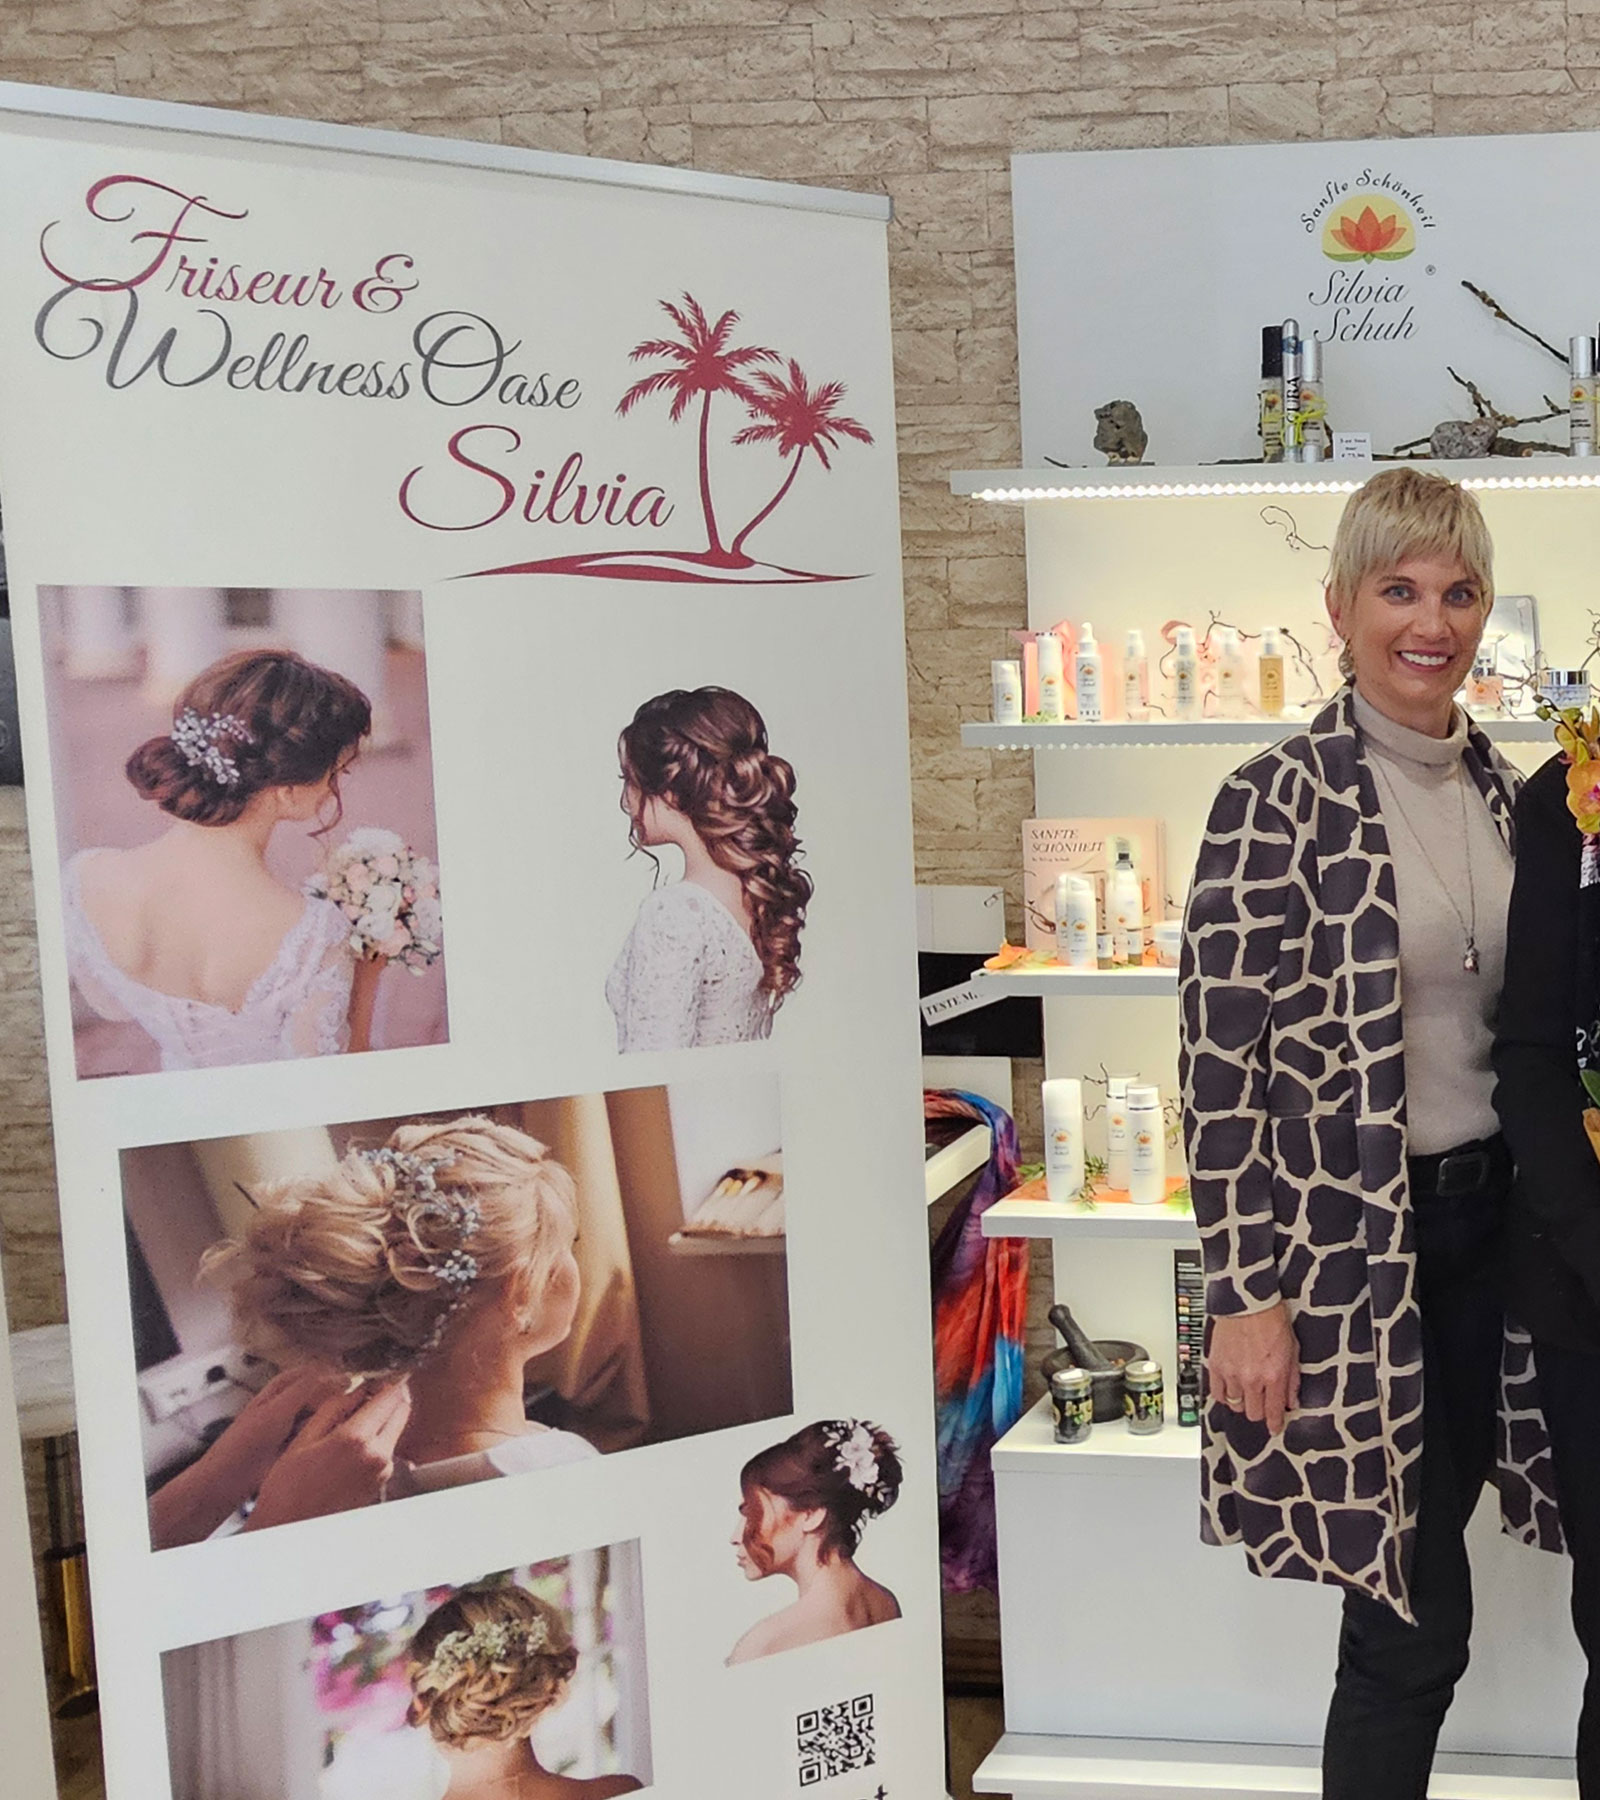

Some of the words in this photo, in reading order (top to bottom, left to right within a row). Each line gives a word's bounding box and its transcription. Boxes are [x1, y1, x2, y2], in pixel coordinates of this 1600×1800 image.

[1301, 180, 1349, 234] Sanfte
[1355, 168, 1437, 229] Schönheit
[40, 174, 343, 310] Friseur
[352, 254, 420, 313] &
[1308, 269, 1409, 306] Silvia
[1313, 306, 1420, 343] Schuh
[399, 425, 675, 531] Silvia
[1030, 828, 1080, 840] SANFTE
[1031, 840, 1105, 854] SCHÖNHEIT
